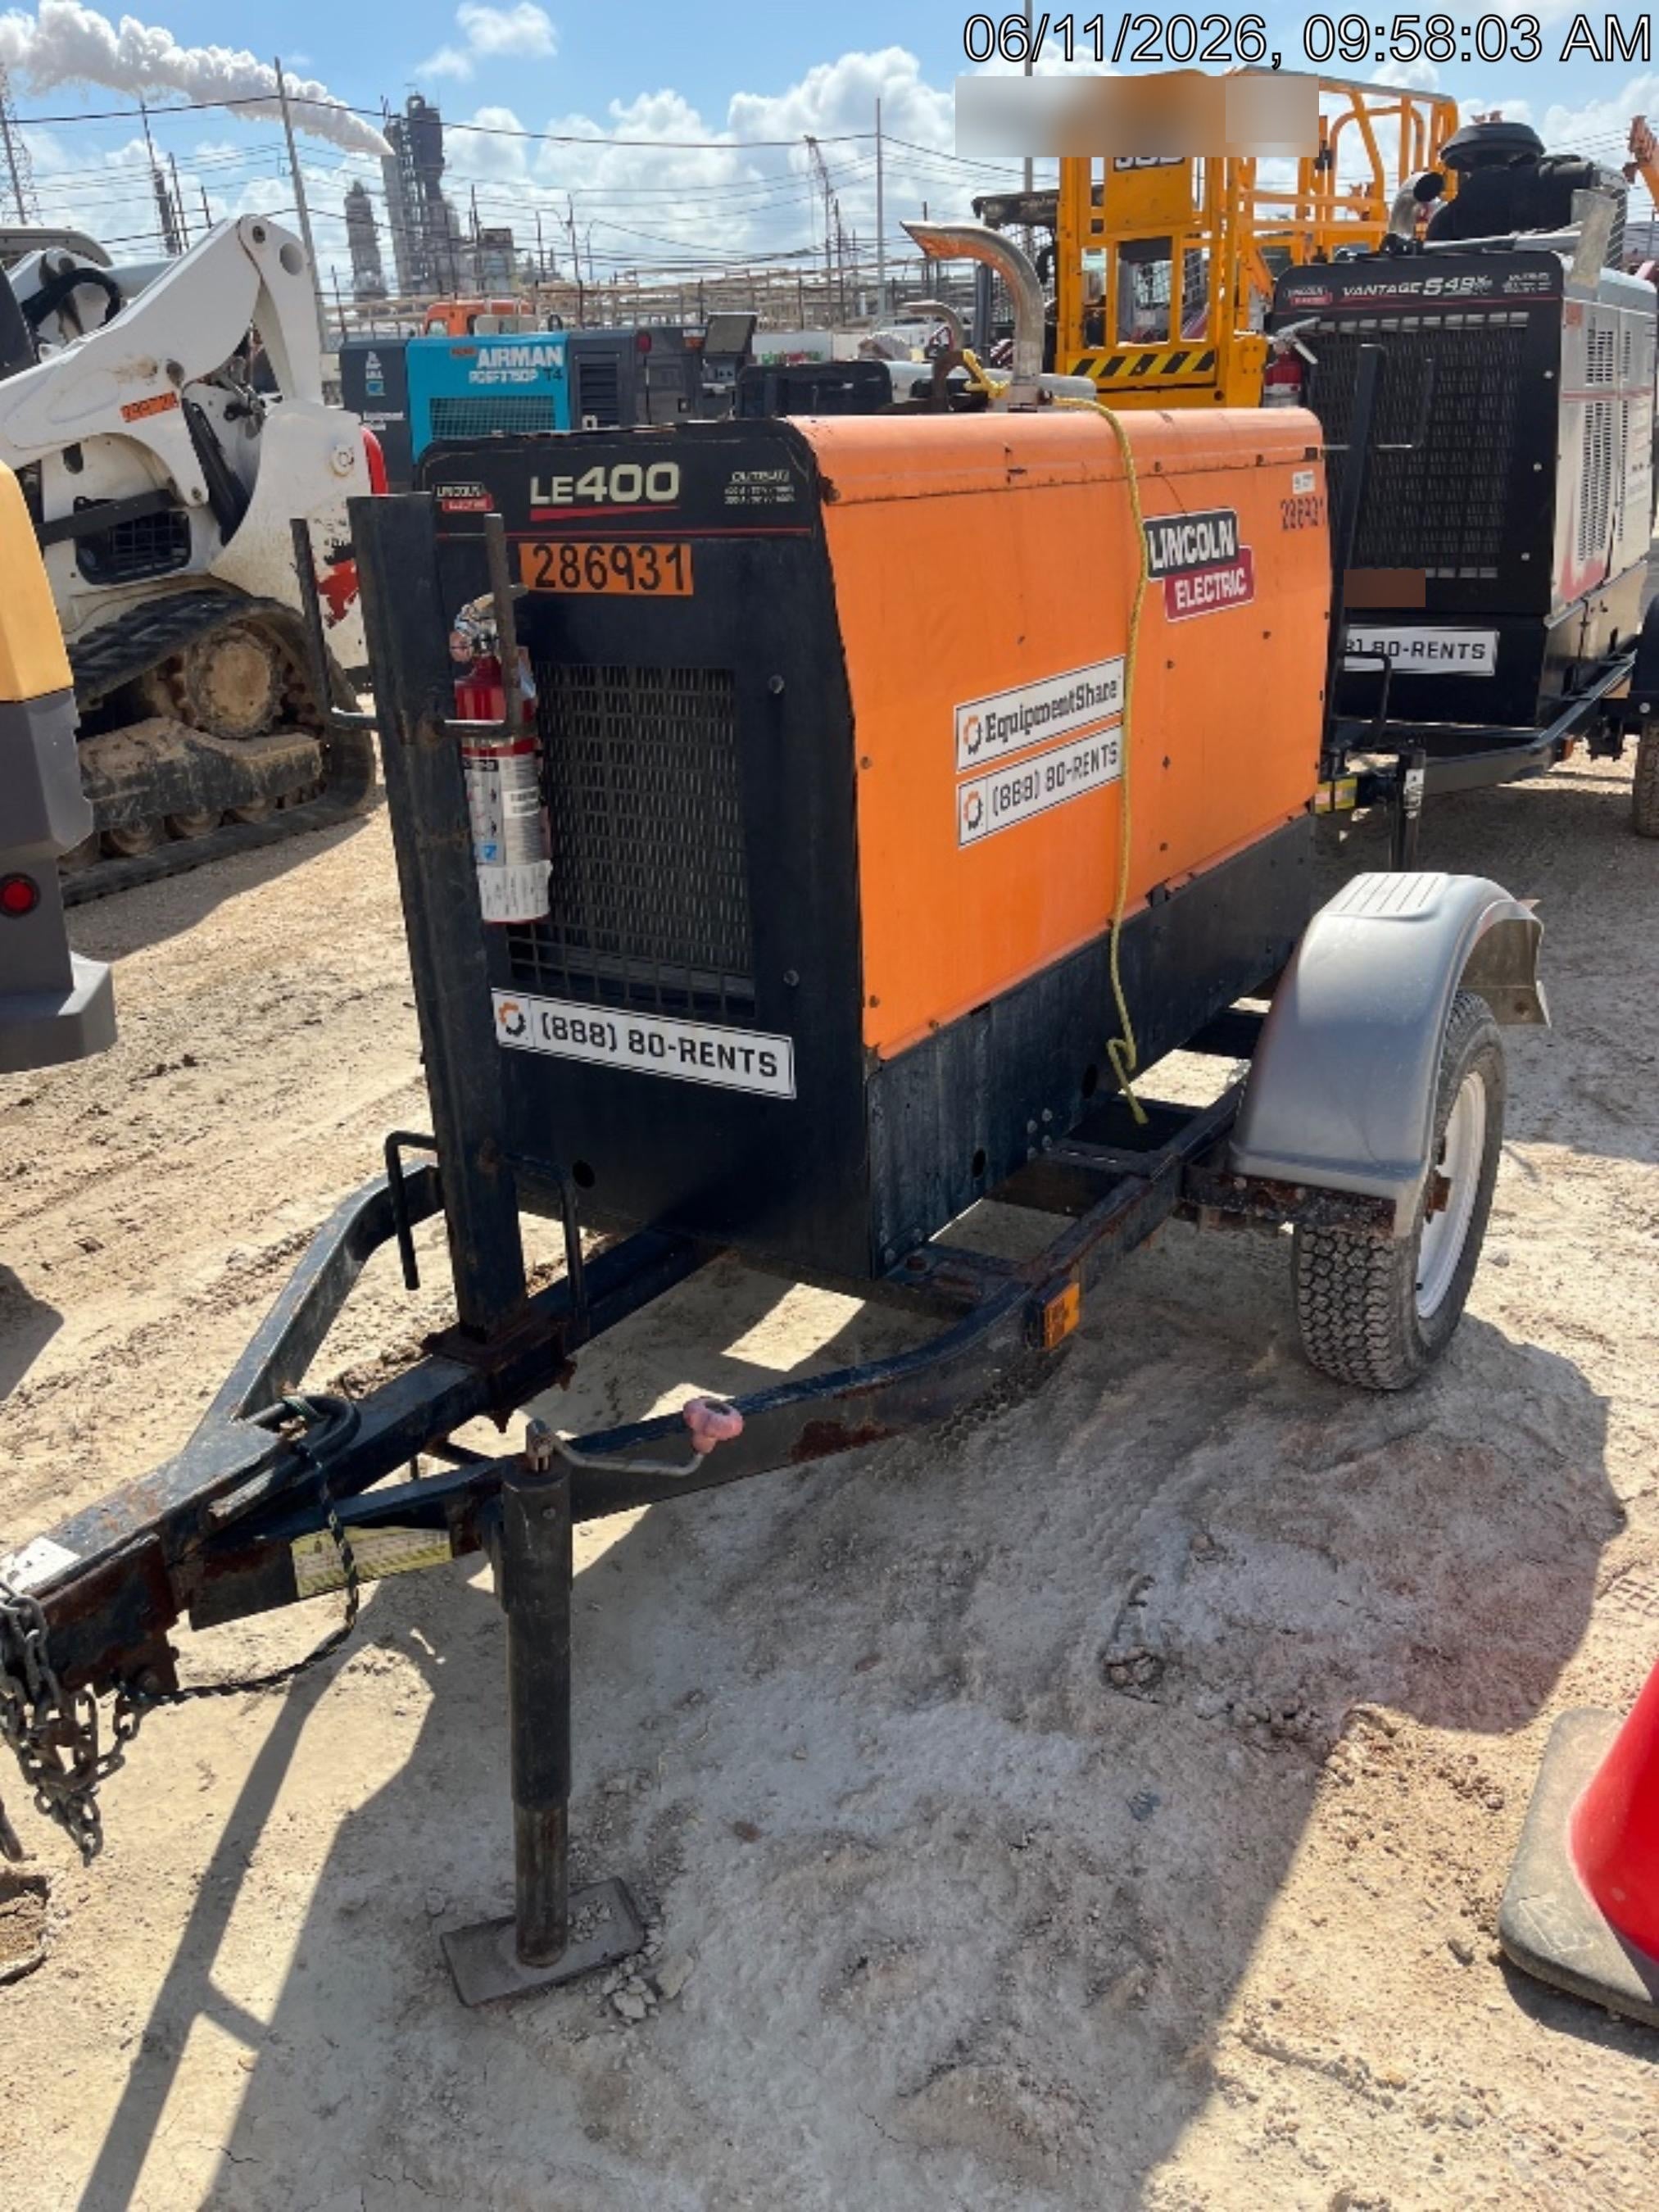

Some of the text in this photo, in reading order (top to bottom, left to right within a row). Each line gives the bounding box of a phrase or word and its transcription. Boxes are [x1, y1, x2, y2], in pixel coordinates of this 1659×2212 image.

[1343, 282, 1423, 296] VANTAGE
[477, 346, 564, 368] AIRMAN
[544, 368, 563, 381] T4
[530, 462, 680, 505] LE400
[533, 543, 684, 591] 286931
[1148, 518, 1235, 571] LINCOLN
[1175, 567, 1247, 610] ELECTRIC
[985, 680, 1117, 744] EquipmentShare
[992, 741, 1118, 817] (888) 80-RENTS
[542, 1011, 777, 1077] (888) 80-RENTS
